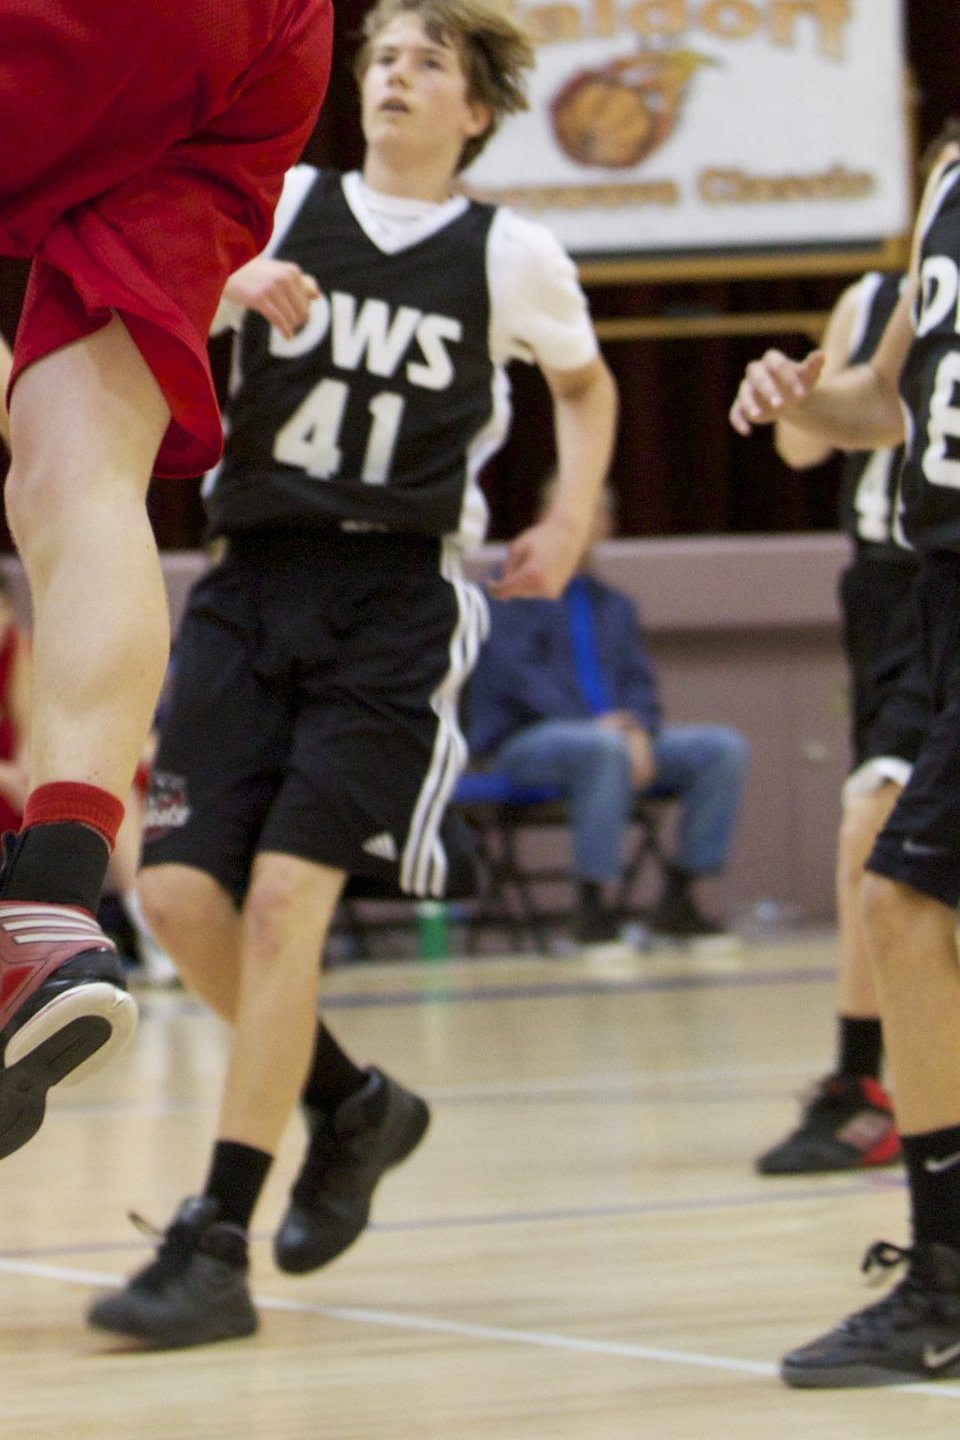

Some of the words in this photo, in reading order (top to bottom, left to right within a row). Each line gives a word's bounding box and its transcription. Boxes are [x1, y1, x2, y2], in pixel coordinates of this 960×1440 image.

[269, 291, 463, 391] DWS
[915, 255, 960, 335] D
[272, 378, 405, 485] 41
